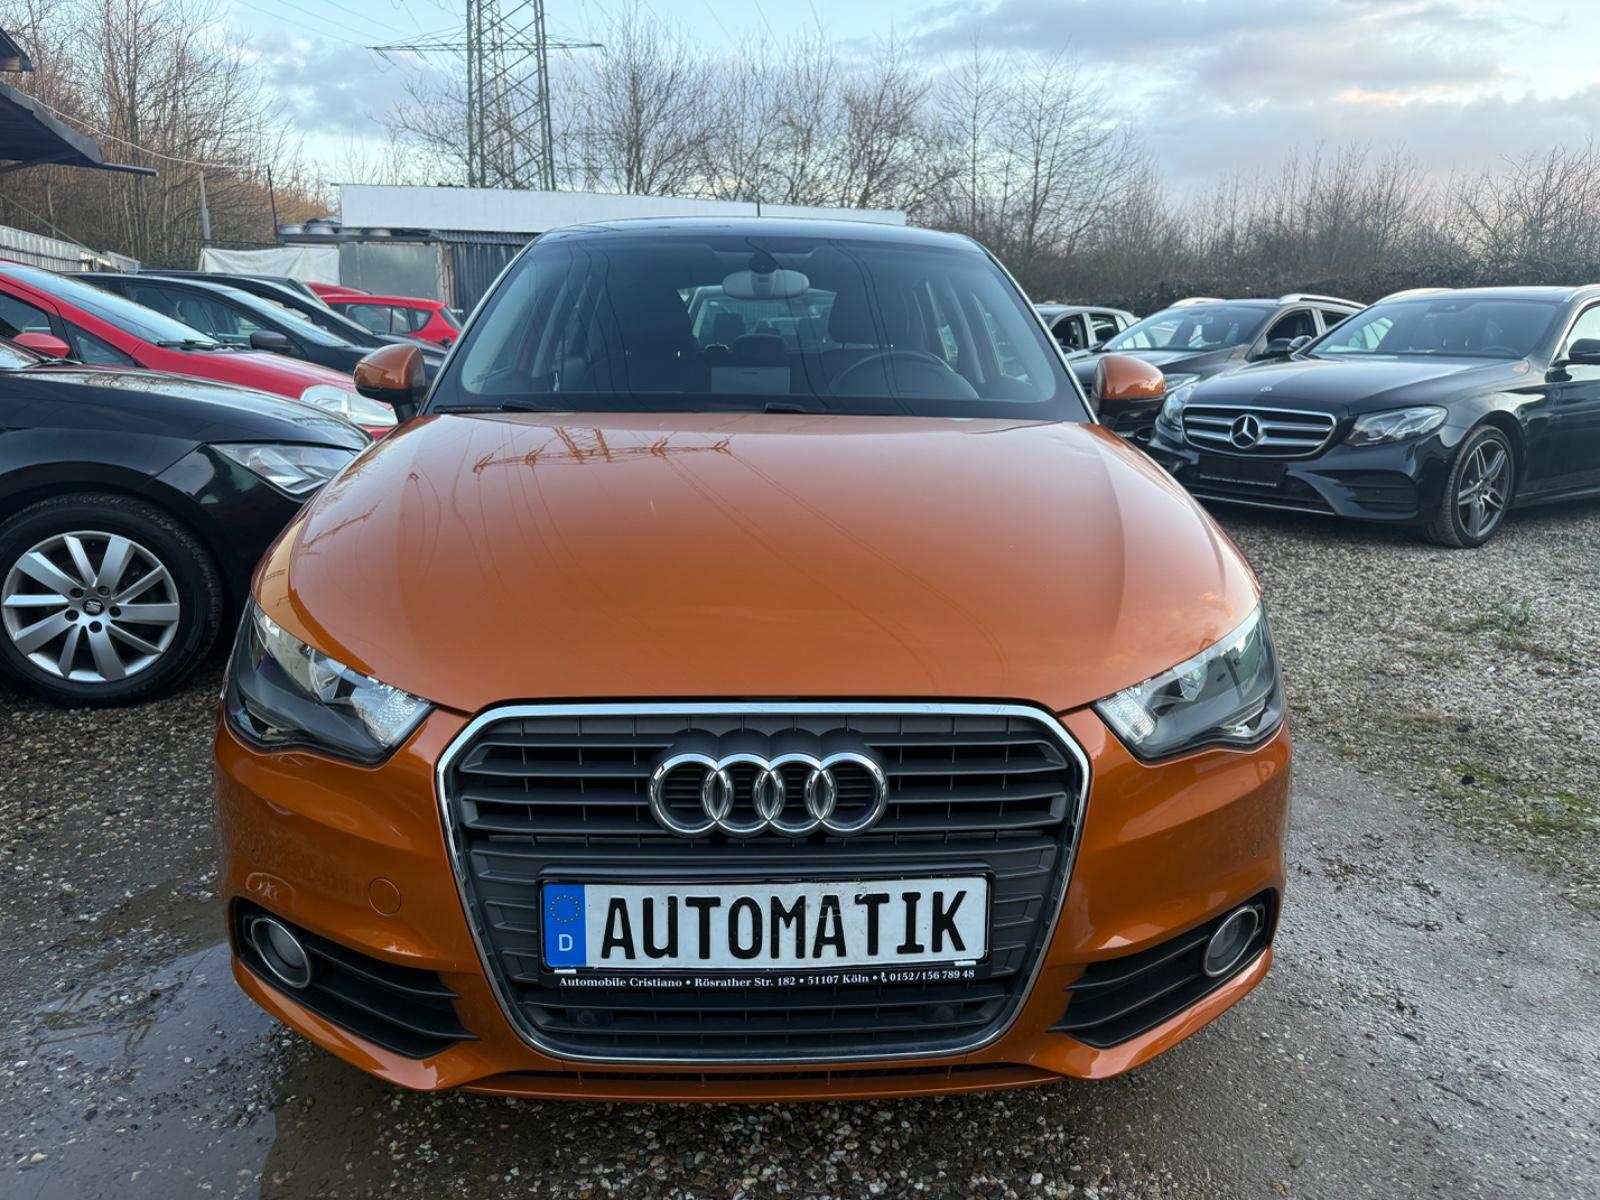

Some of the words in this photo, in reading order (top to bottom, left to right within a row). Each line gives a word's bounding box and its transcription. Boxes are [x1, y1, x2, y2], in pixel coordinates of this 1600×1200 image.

[601, 890, 968, 960] AUTOMATIK
[559, 977, 627, 987] Automobile
[629, 977, 683, 988] Cristiano
[694, 977, 752, 987] Rösrather
[754, 977, 774, 987] Str.
[777, 976, 796, 986] 182
[807, 975, 839, 985] 51107
[842, 974, 869, 984] Köln
